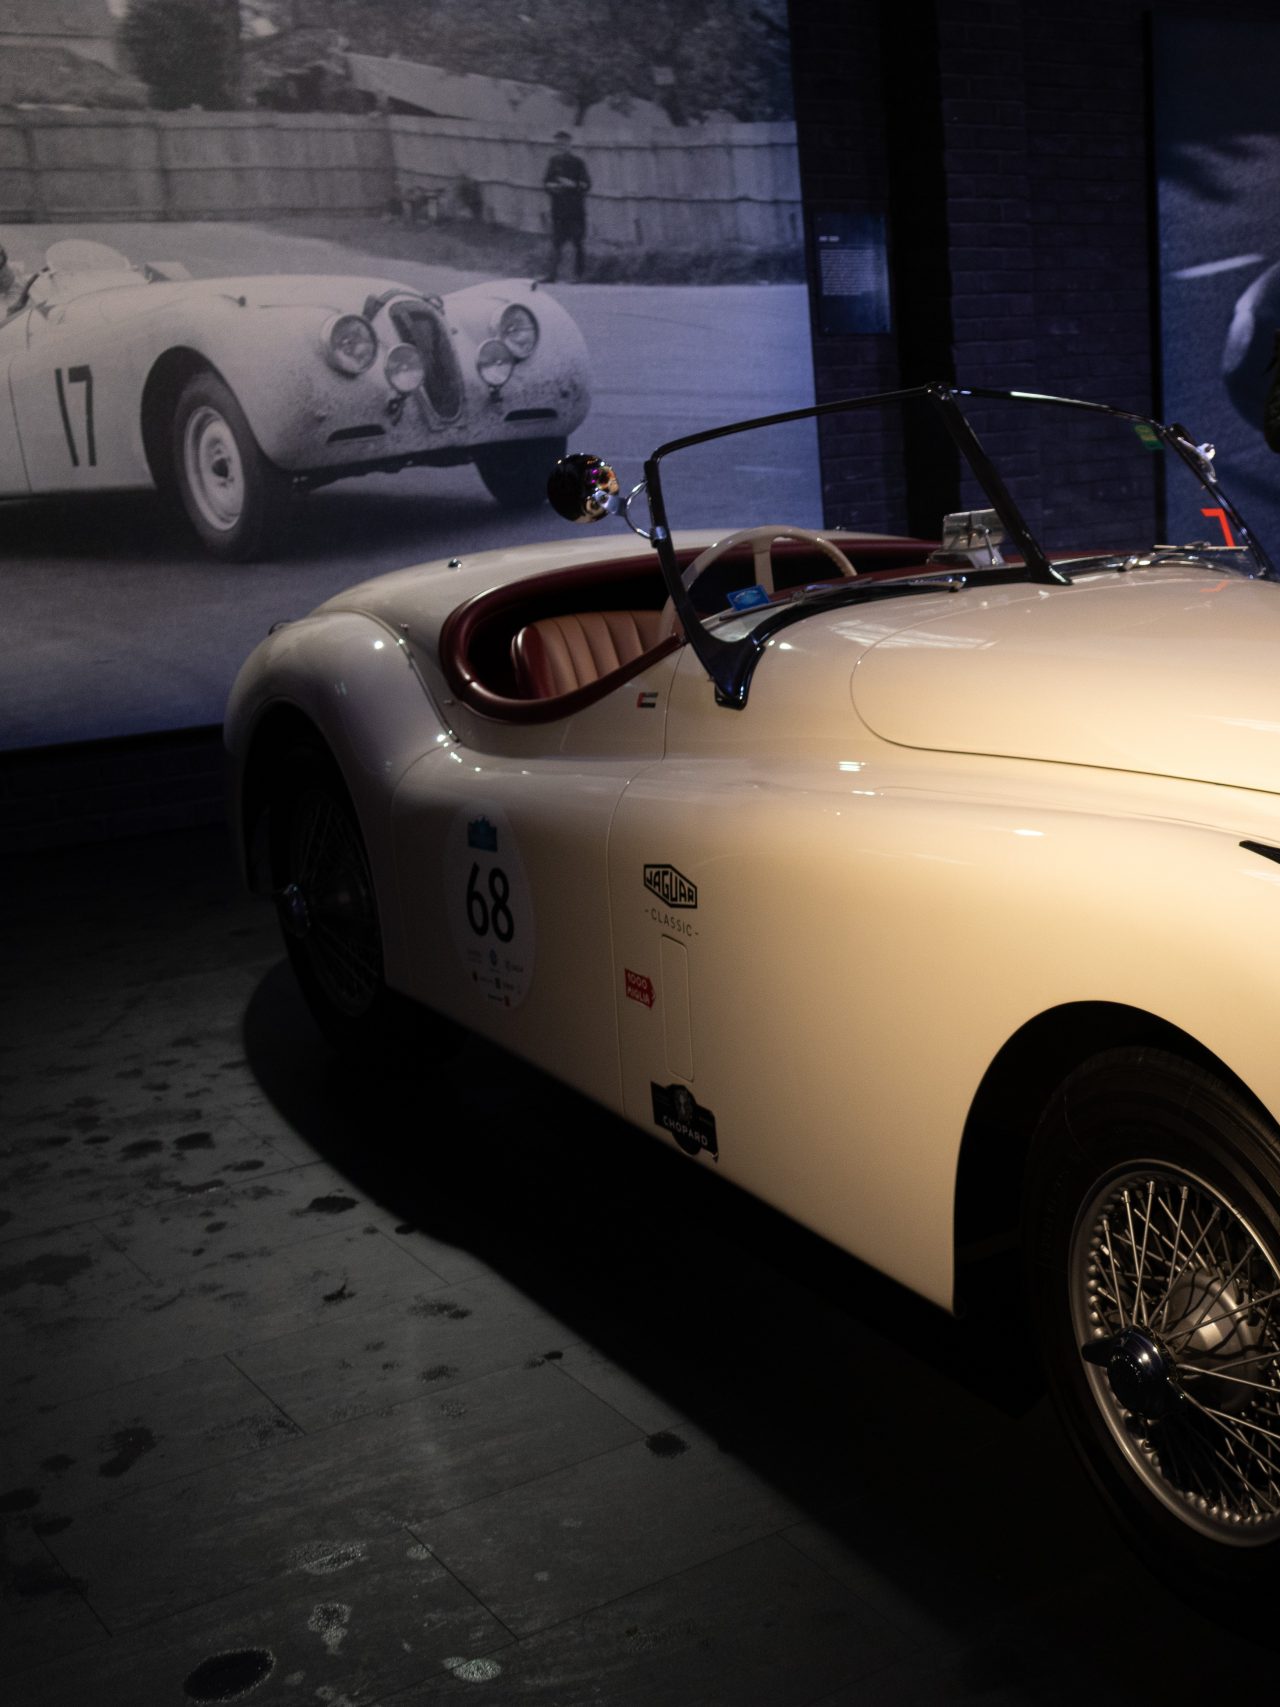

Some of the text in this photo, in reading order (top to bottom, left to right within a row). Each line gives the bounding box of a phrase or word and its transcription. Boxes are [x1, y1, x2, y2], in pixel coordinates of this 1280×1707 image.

[55, 365, 97, 467] 17
[466, 862, 514, 942] 68
[646, 870, 694, 903] JAGUAR
[651, 908, 692, 937] CLASSIC
[627, 972, 648, 990] 1000
[663, 1114, 708, 1148] CHOPARD
